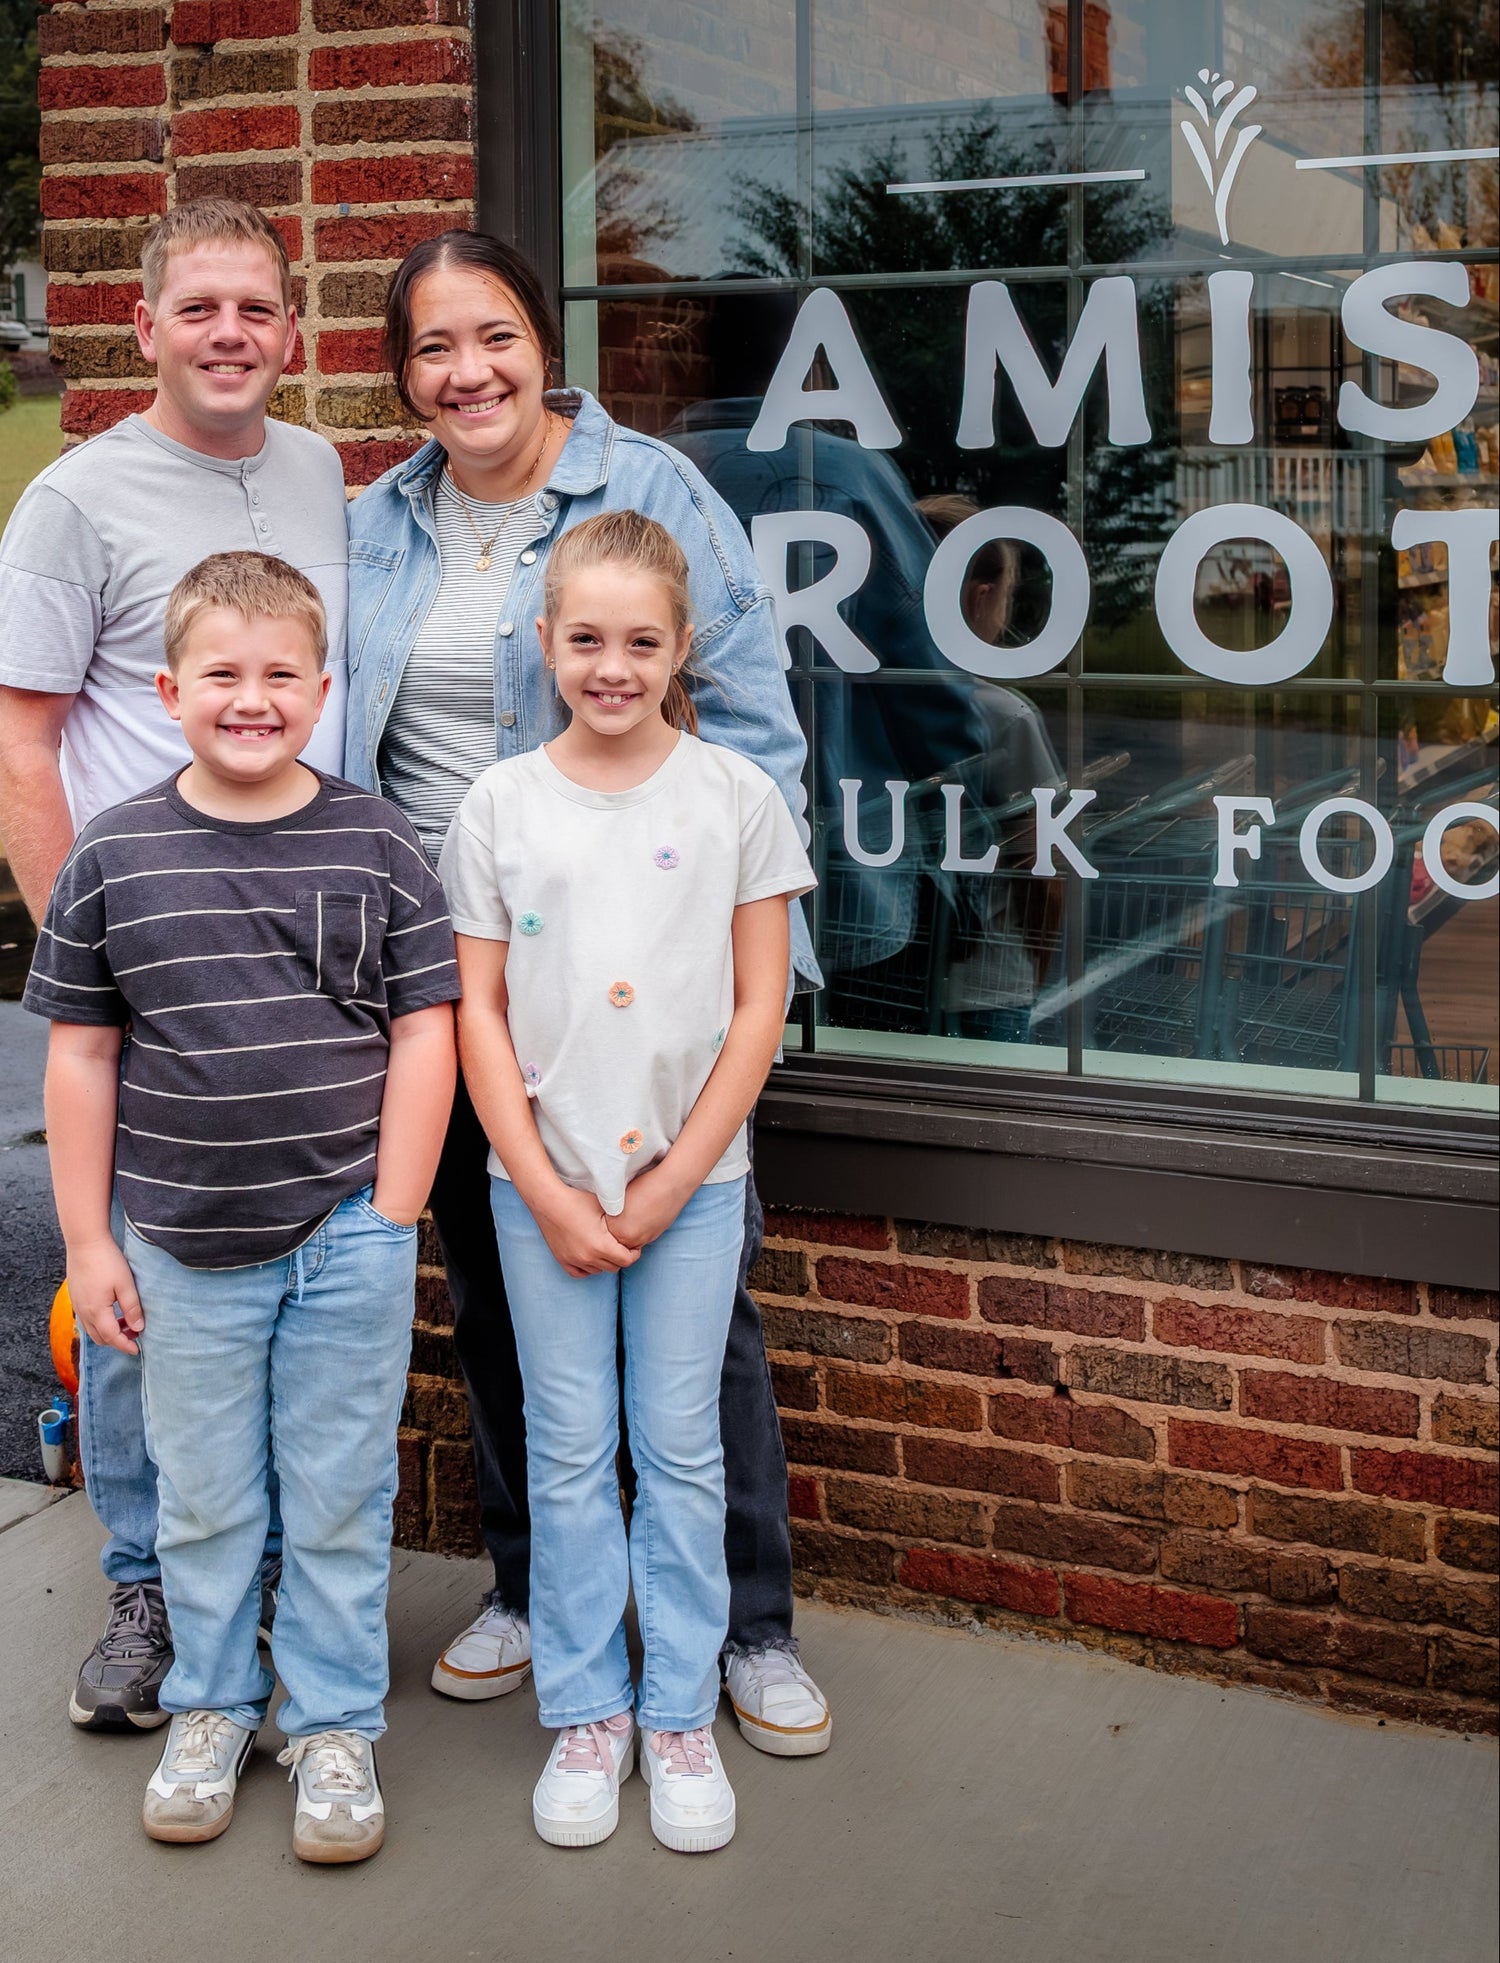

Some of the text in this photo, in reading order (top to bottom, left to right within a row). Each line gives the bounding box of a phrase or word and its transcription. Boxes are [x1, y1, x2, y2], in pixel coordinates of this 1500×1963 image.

[746, 261, 1480, 452] AMIS
[751, 503, 1499, 686] ROOT
[794, 779, 1499, 900] ULK FOO
